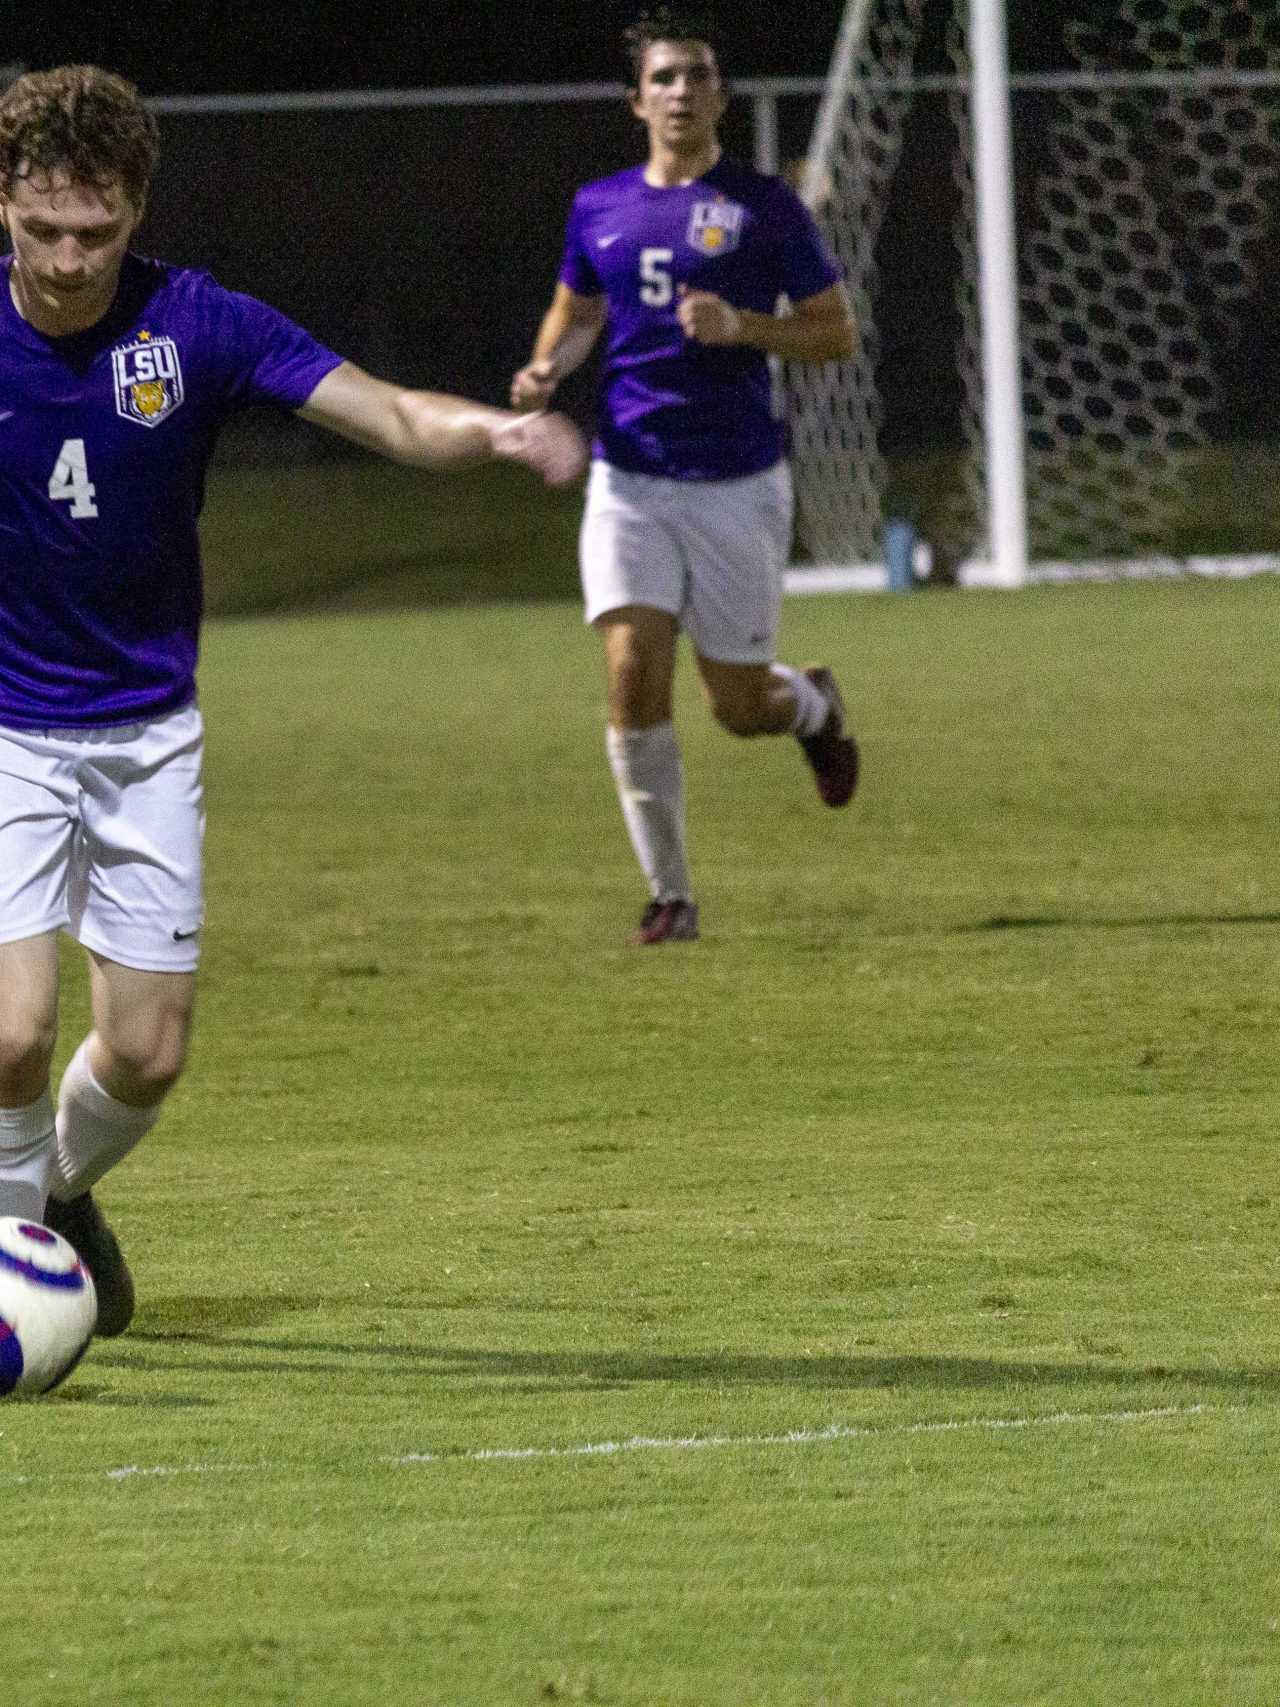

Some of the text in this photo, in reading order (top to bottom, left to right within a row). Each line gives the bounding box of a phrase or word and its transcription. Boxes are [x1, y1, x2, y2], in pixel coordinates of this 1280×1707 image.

[639, 247, 673, 307] 5
[117, 344, 176, 387] LSU
[47, 438, 98, 520] 4
